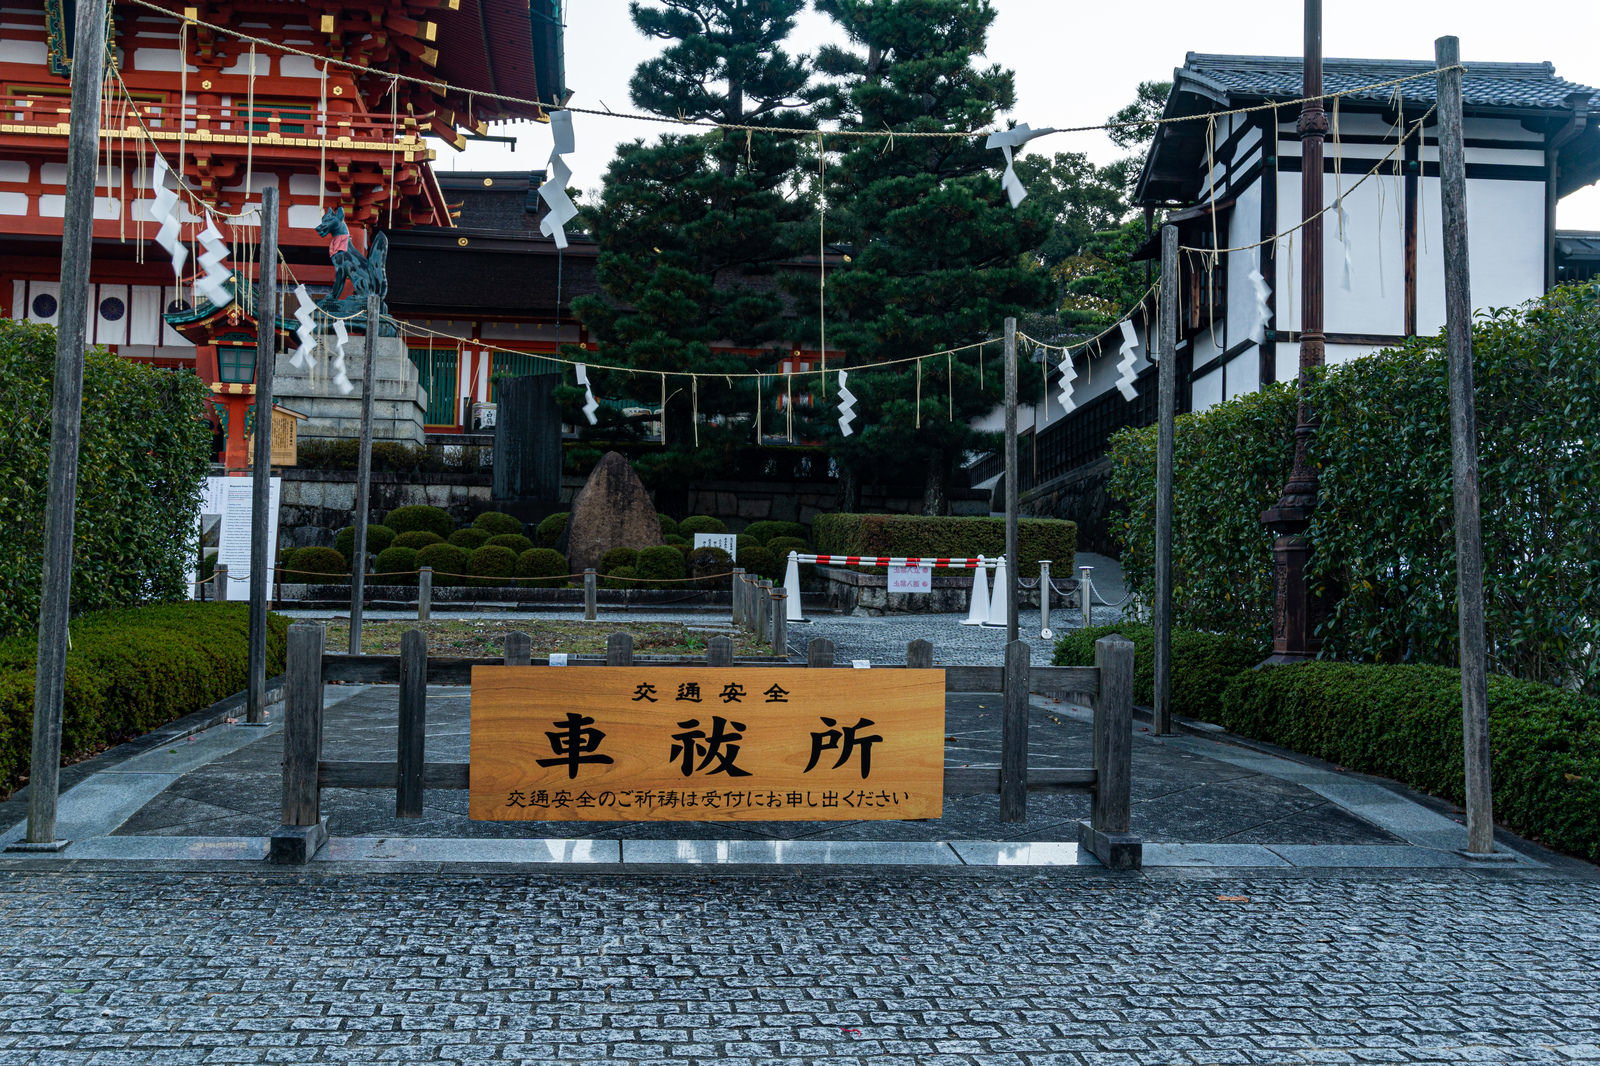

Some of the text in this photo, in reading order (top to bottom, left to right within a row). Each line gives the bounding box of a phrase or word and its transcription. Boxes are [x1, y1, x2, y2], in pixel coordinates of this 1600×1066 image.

[631, 682, 791, 704] 交通安全
[535, 712, 884, 780] 車祓所
[505, 789, 910, 809] 交通安全のご祈祷は受付にお申し出ください
